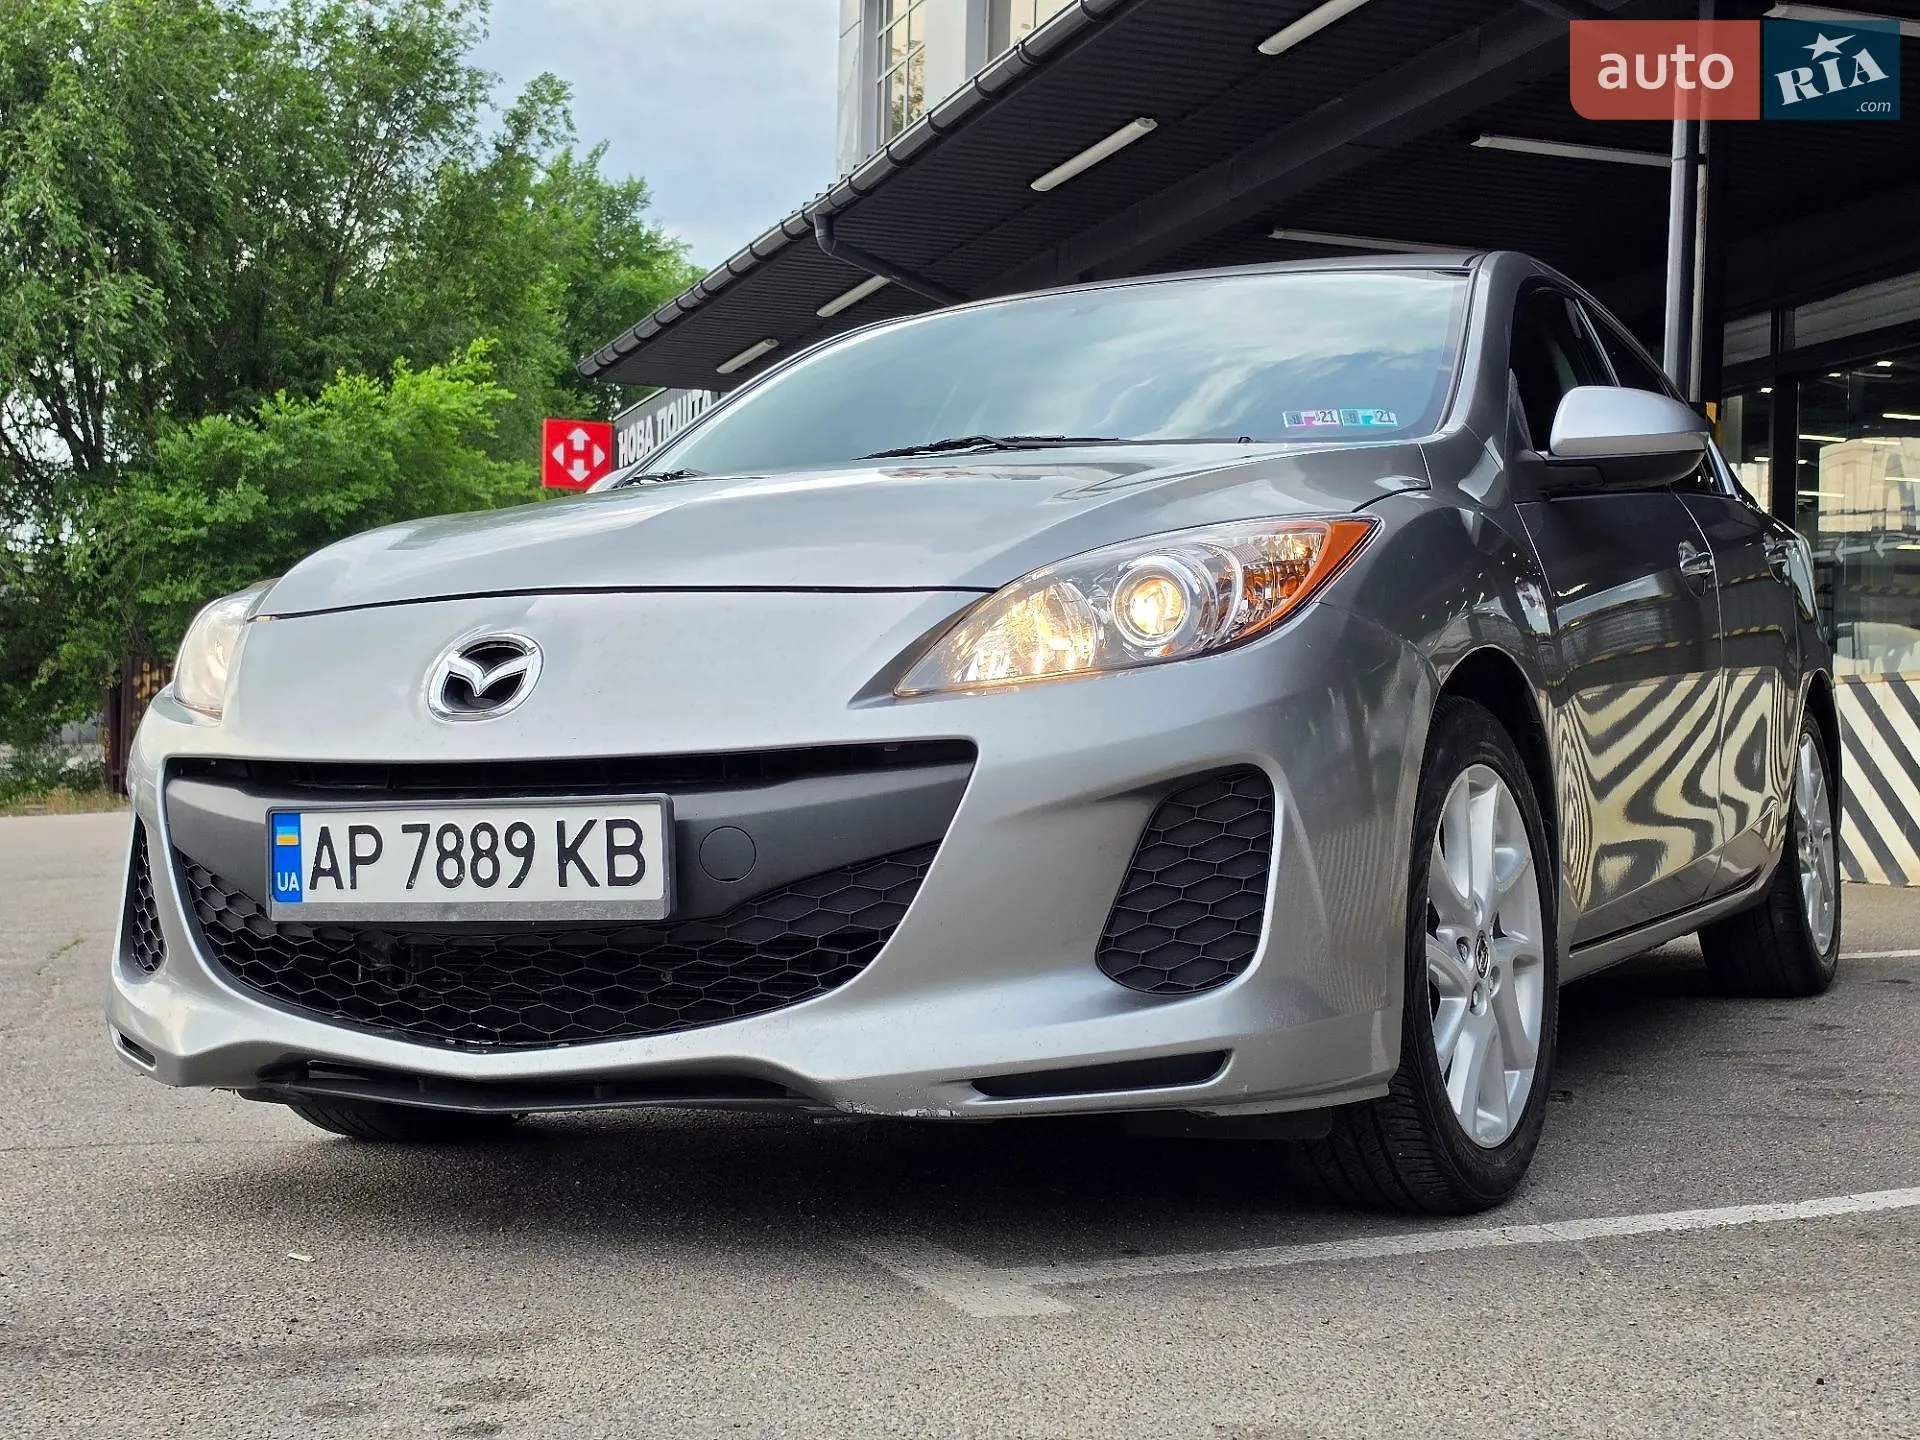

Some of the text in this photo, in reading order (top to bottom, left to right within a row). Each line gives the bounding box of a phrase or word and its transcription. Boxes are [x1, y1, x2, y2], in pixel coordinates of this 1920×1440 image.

[617, 415, 655, 468] НОВА
[308, 818, 647, 891] AP 7889 KB
[276, 871, 301, 892] UA
